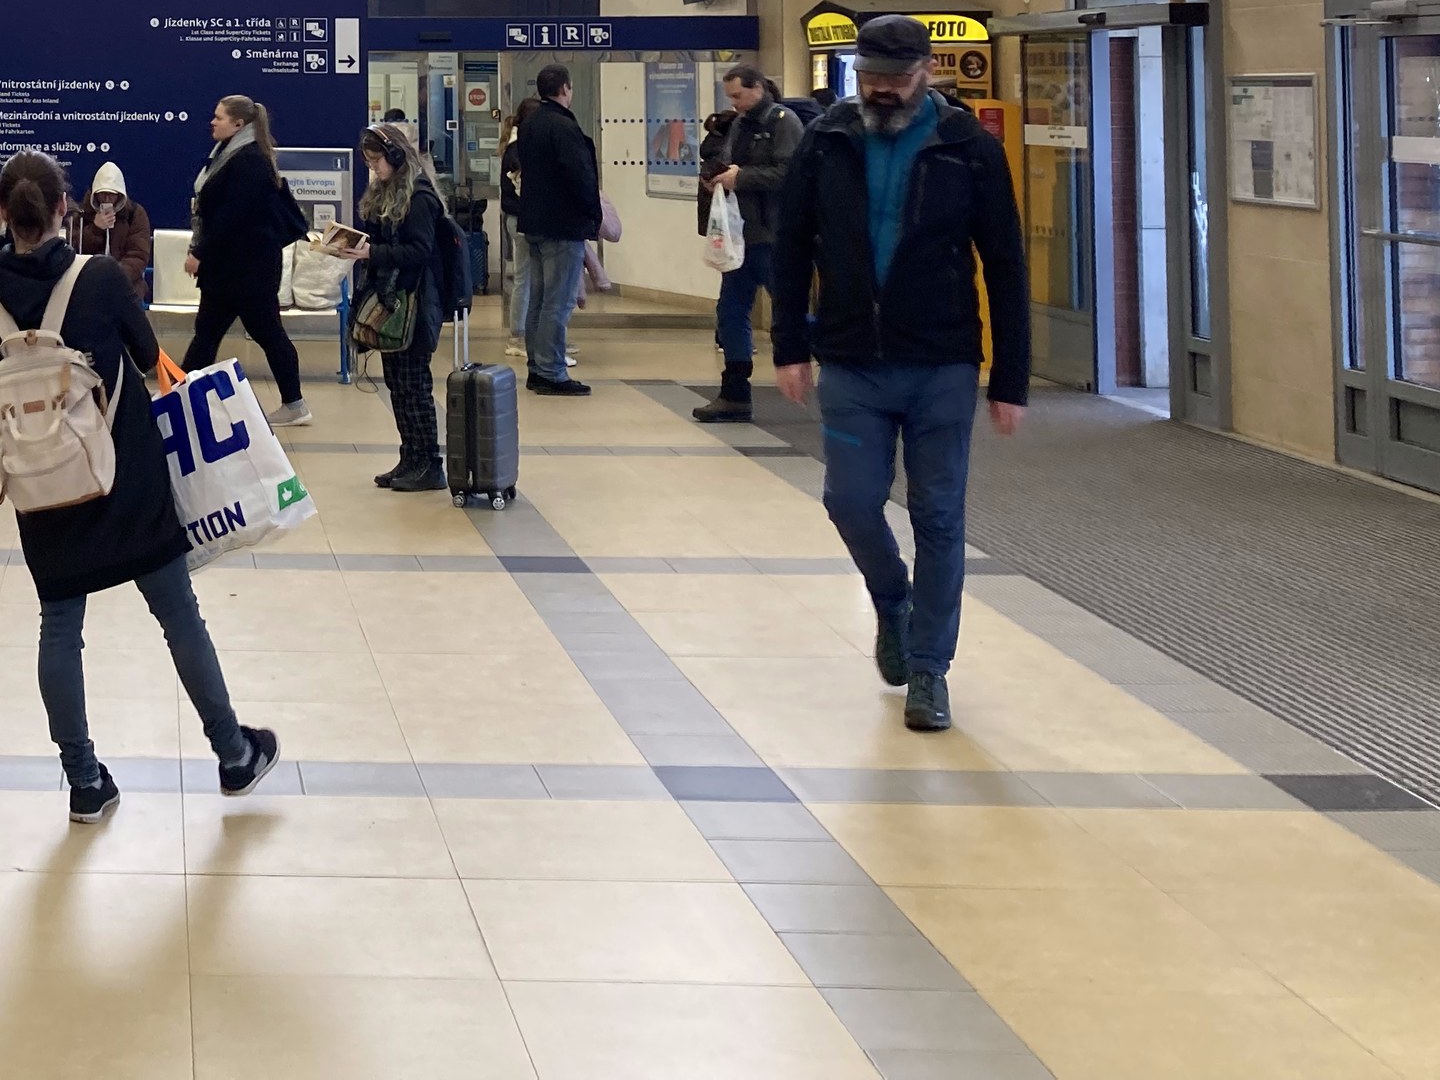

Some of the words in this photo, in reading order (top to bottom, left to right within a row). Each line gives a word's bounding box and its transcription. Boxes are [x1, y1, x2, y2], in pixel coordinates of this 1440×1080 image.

[164, 18, 208, 29] Jízdenky
[210, 18, 224, 27] SC
[234, 18, 244, 27] 1.
[246, 17, 271, 28] třída
[929, 21, 967, 38] FOTO
[246, 49, 299, 59] Směnárna
[933, 53, 956, 68] OTO
[58, 80, 101, 91] jízdenky
[62, 111, 119, 121] vnitrostátní
[119, 111, 160, 123] jízdenky
[51, 141, 82, 154] služby
[187, 501, 247, 545] TION
